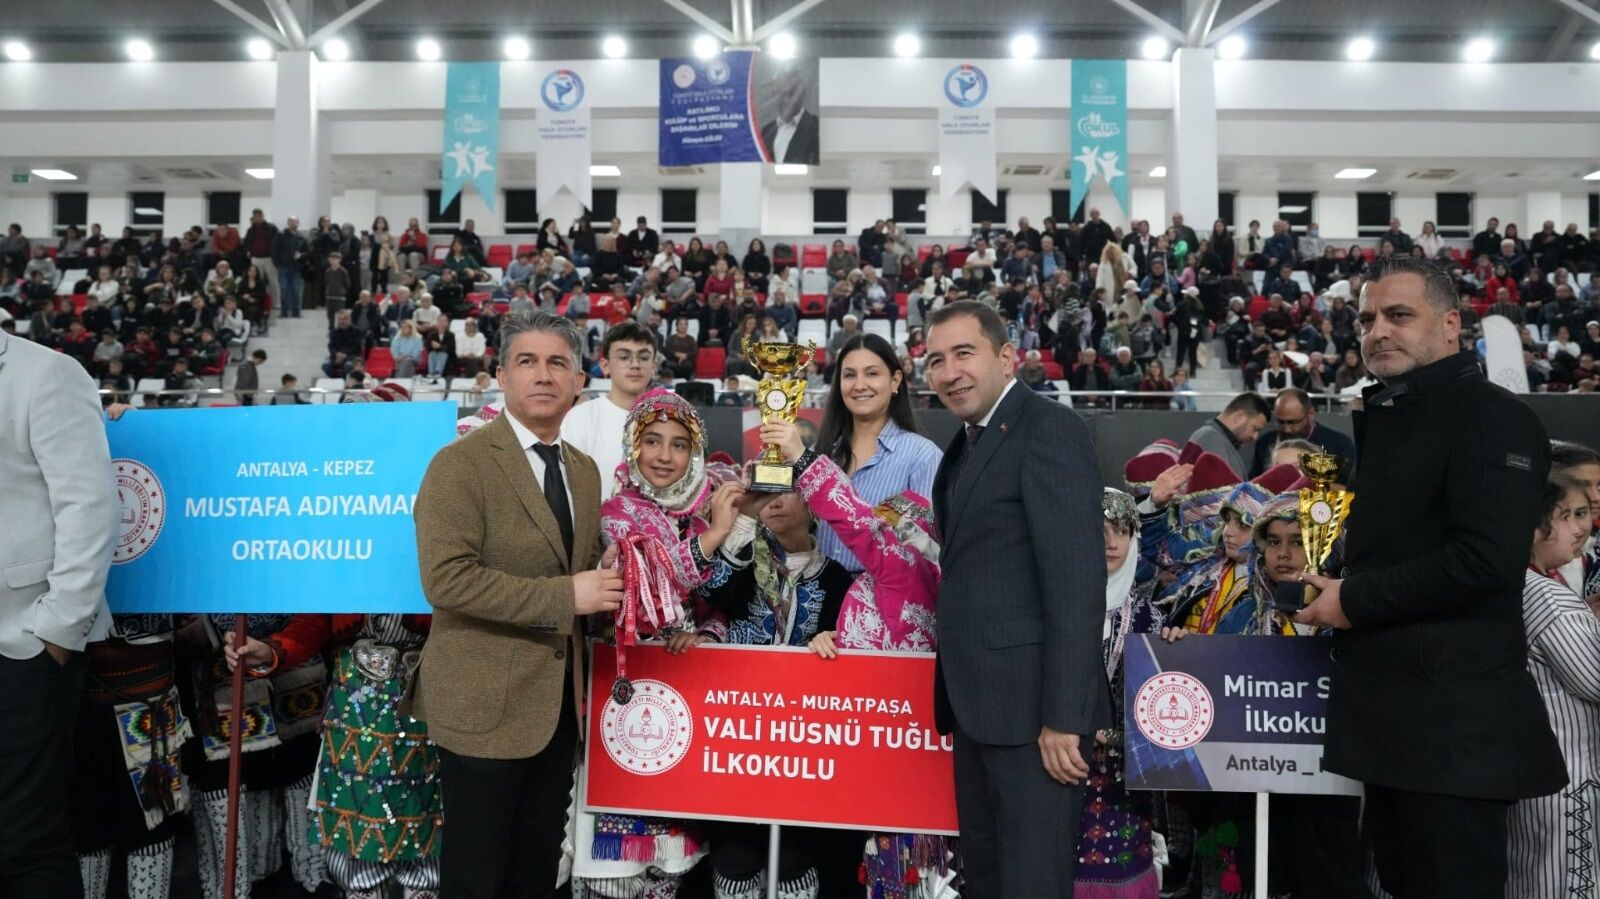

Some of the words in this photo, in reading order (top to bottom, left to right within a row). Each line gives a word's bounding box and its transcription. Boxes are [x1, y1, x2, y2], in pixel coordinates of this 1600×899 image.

[236, 462, 308, 478] ANTALYA
[323, 460, 374, 476] KEPEZ
[184, 497, 291, 518] MUSTAFA
[231, 539, 373, 560] ORTAOKULU
[1224, 675, 1309, 698] Mimar
[1316, 676, 1331, 699] S
[704, 689, 785, 708] ANTALYA
[802, 694, 913, 718] MURATPAŞA
[703, 714, 762, 741] VALİ
[769, 715, 861, 747] HÜSNÜ
[1245, 705, 1326, 734] İlkoku
[703, 746, 835, 781] İLKOKULU
[1225, 754, 1297, 776] Antalya
